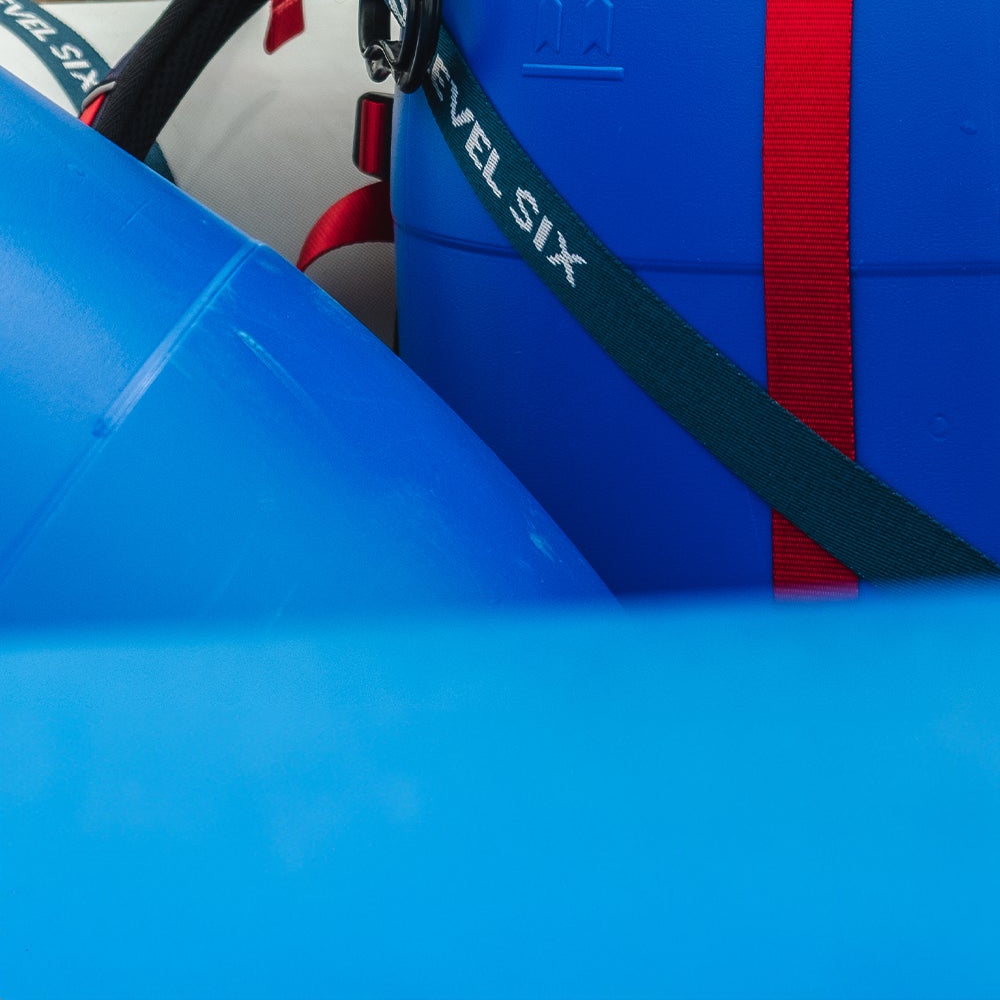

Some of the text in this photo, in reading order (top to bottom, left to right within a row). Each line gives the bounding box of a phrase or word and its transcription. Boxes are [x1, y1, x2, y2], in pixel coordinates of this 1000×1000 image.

[49, 43, 98, 92] SIX
[430, 53, 588, 288] EVEL SIX
